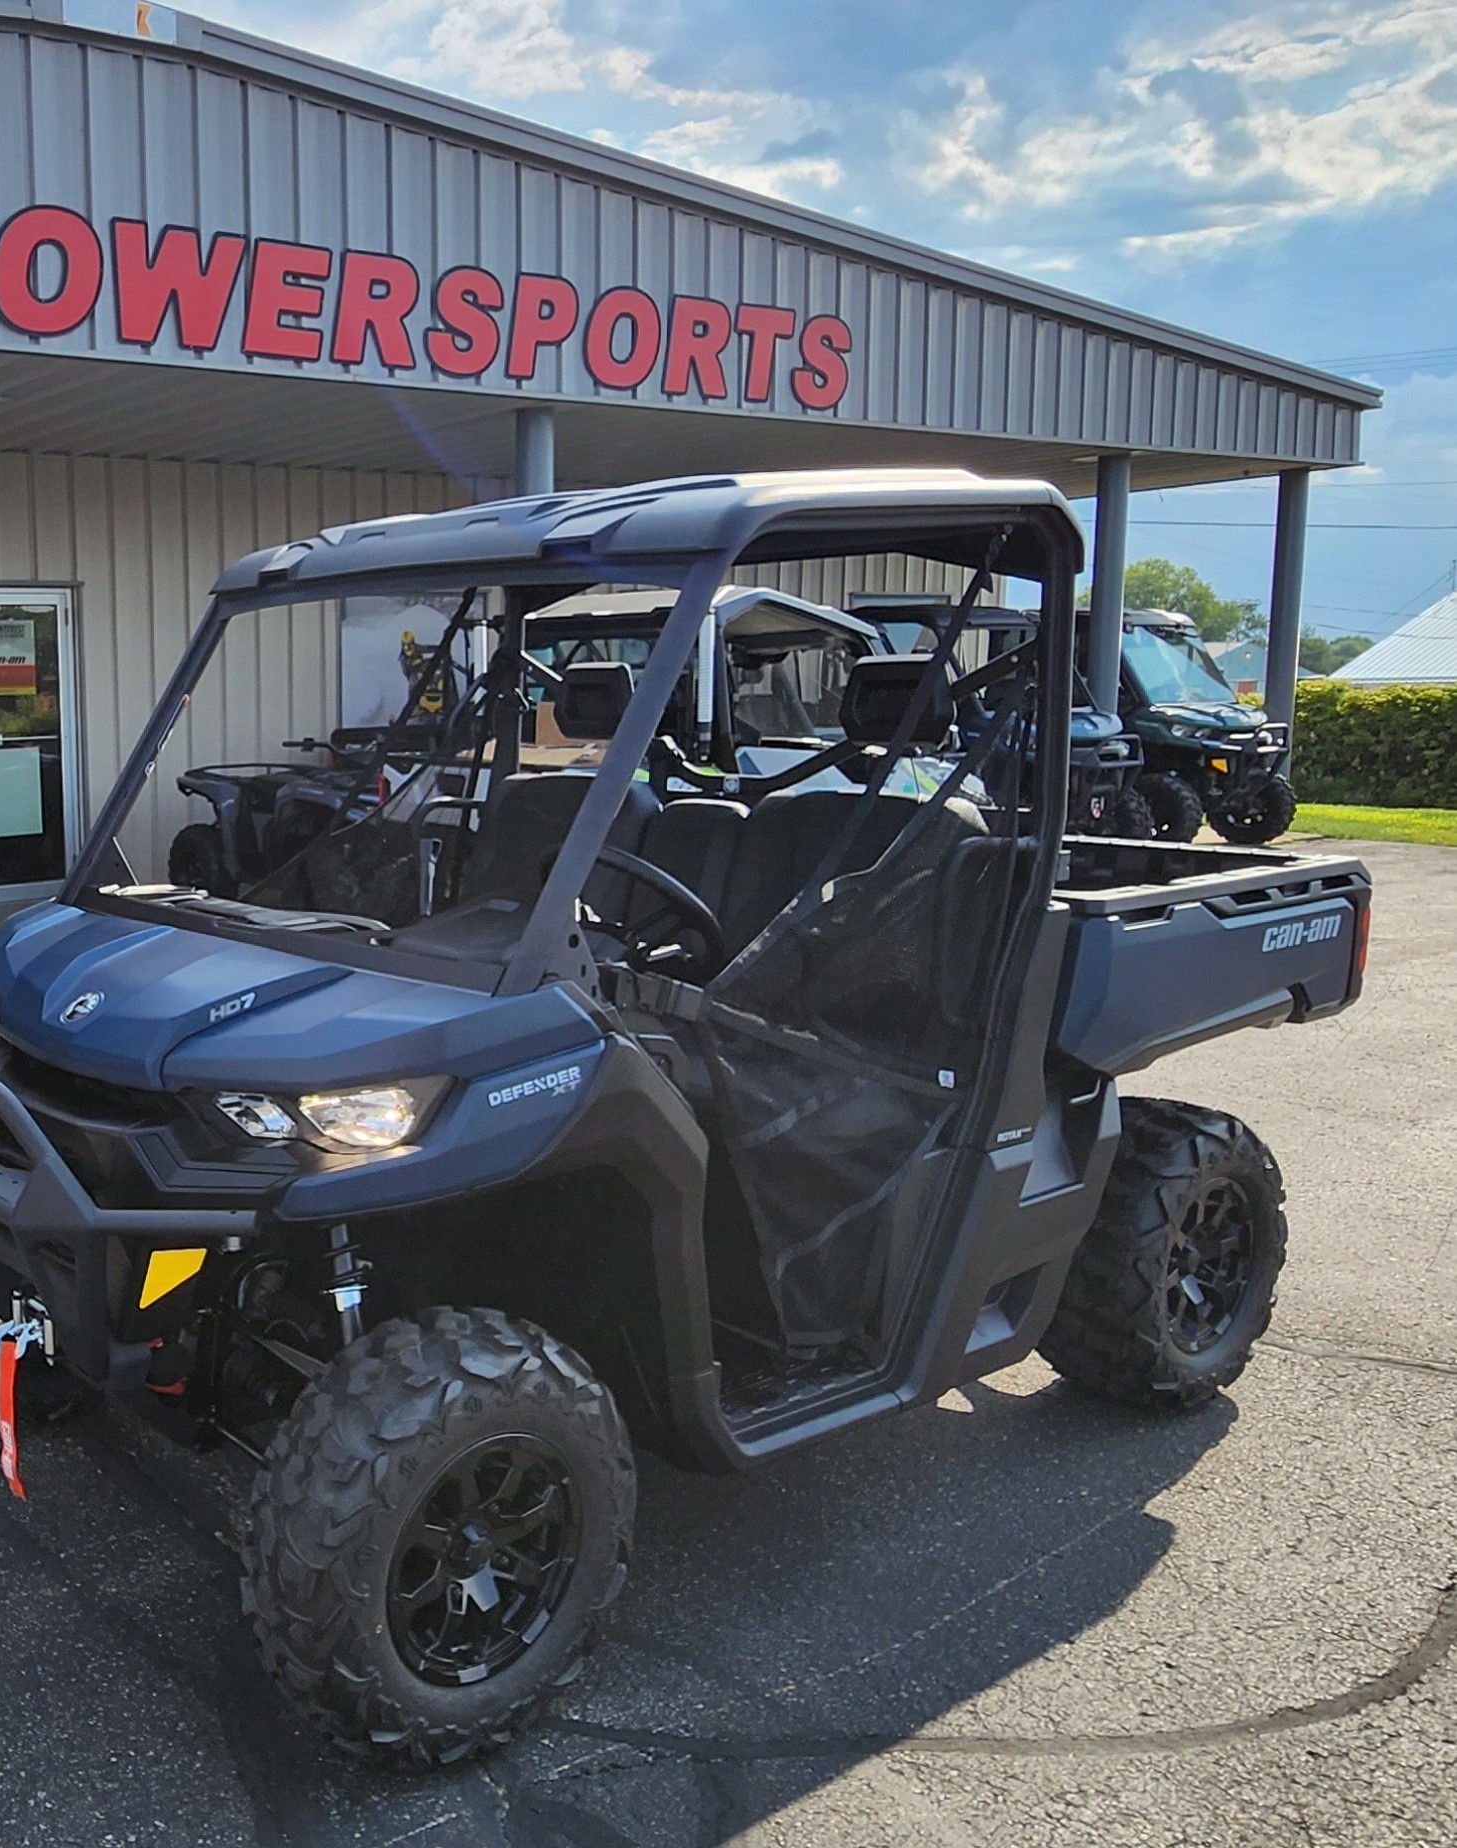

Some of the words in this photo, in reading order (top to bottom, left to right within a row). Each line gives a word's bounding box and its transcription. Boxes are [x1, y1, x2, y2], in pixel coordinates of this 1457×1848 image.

[1262, 914, 1341, 952] can-am
[209, 991, 255, 1022] HD7
[488, 1066, 581, 1107] DEFENDER
[552, 1079, 581, 1097] XT
